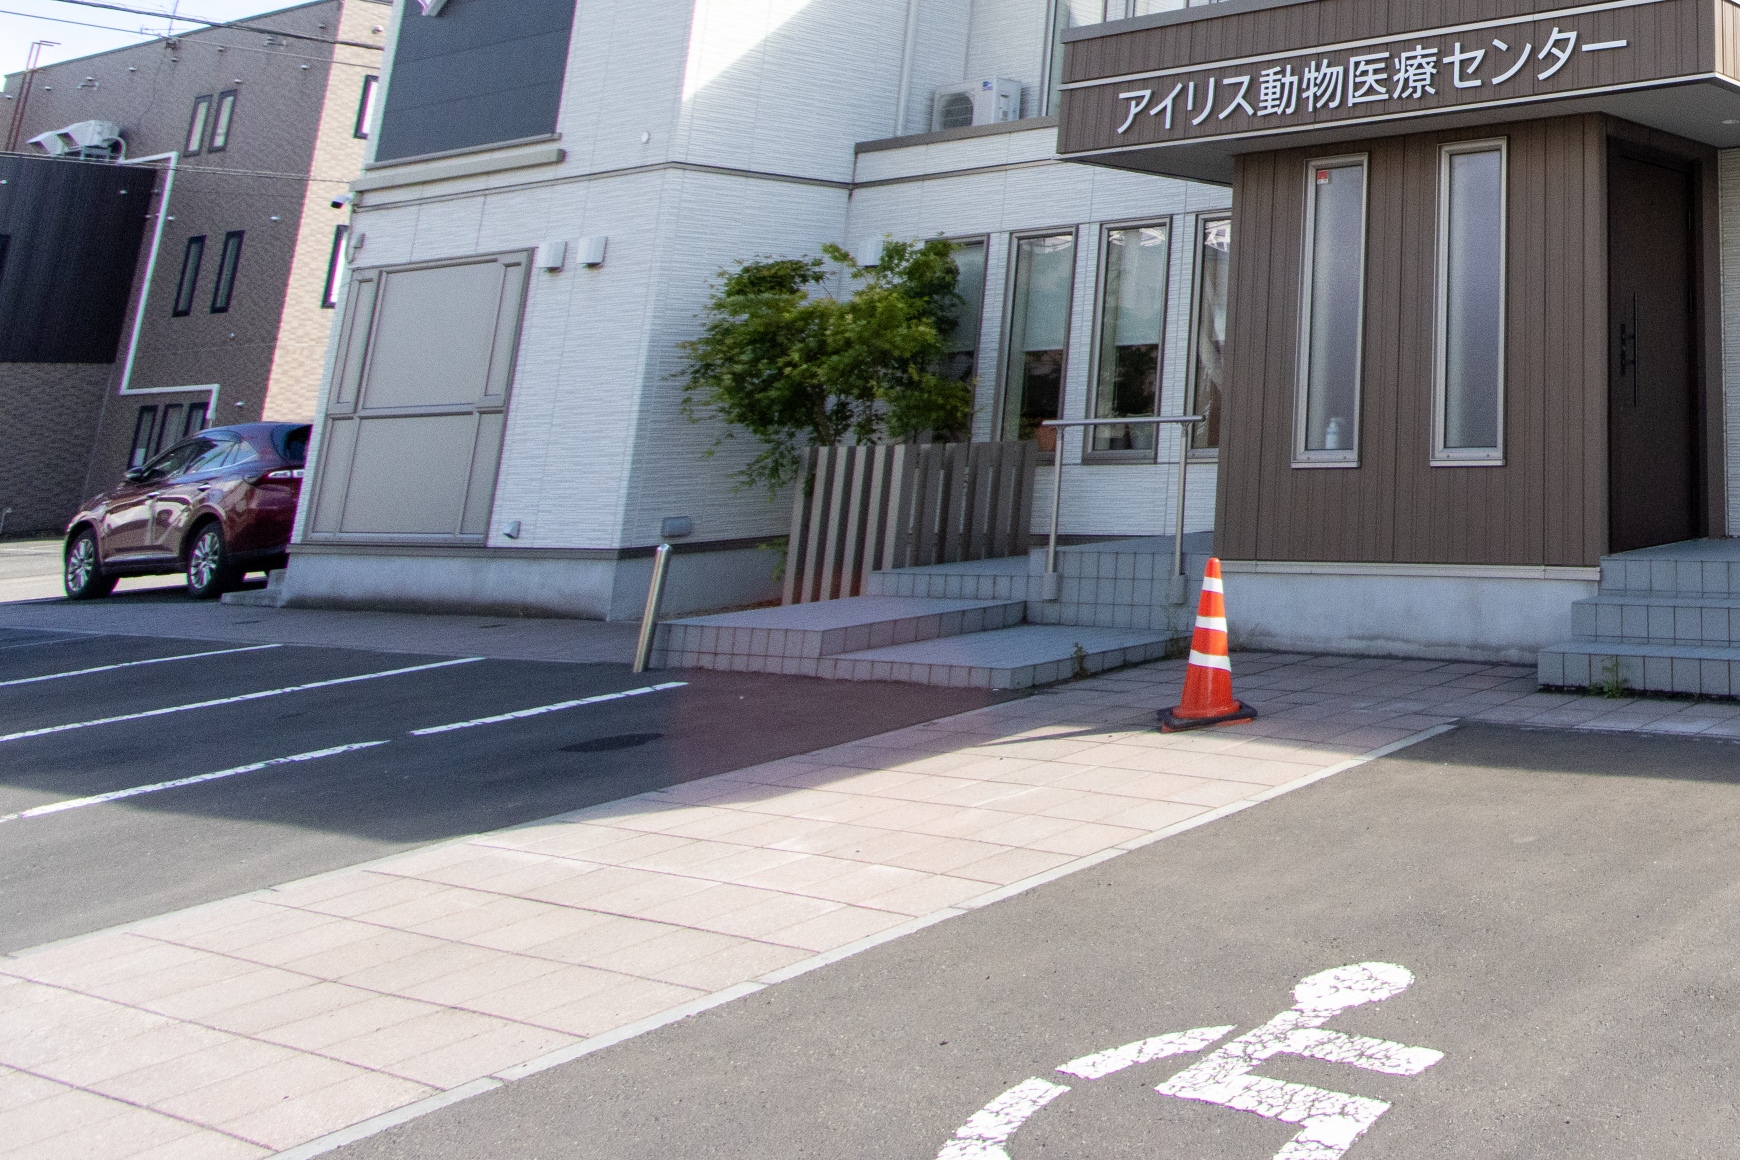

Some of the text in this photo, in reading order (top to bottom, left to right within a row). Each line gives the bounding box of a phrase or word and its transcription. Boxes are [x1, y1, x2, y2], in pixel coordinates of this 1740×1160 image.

[1116, 26, 1628, 134] アイリス動物医療センター
